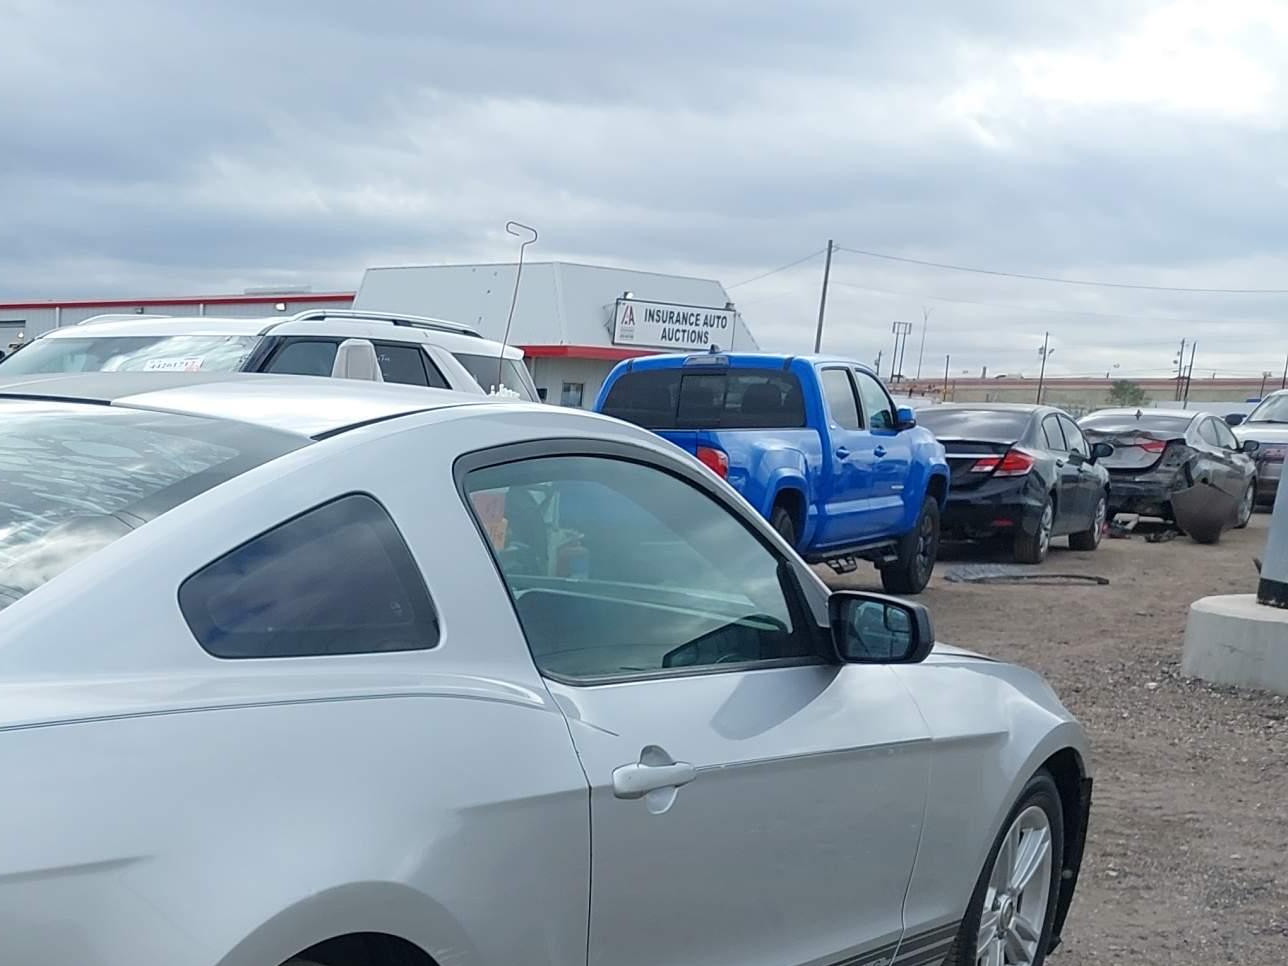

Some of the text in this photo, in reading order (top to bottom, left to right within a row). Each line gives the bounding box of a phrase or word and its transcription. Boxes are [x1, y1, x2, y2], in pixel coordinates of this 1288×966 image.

[643, 308, 728, 329] INSURANCE AUTO
[660, 327, 710, 345] AUCTIONS
